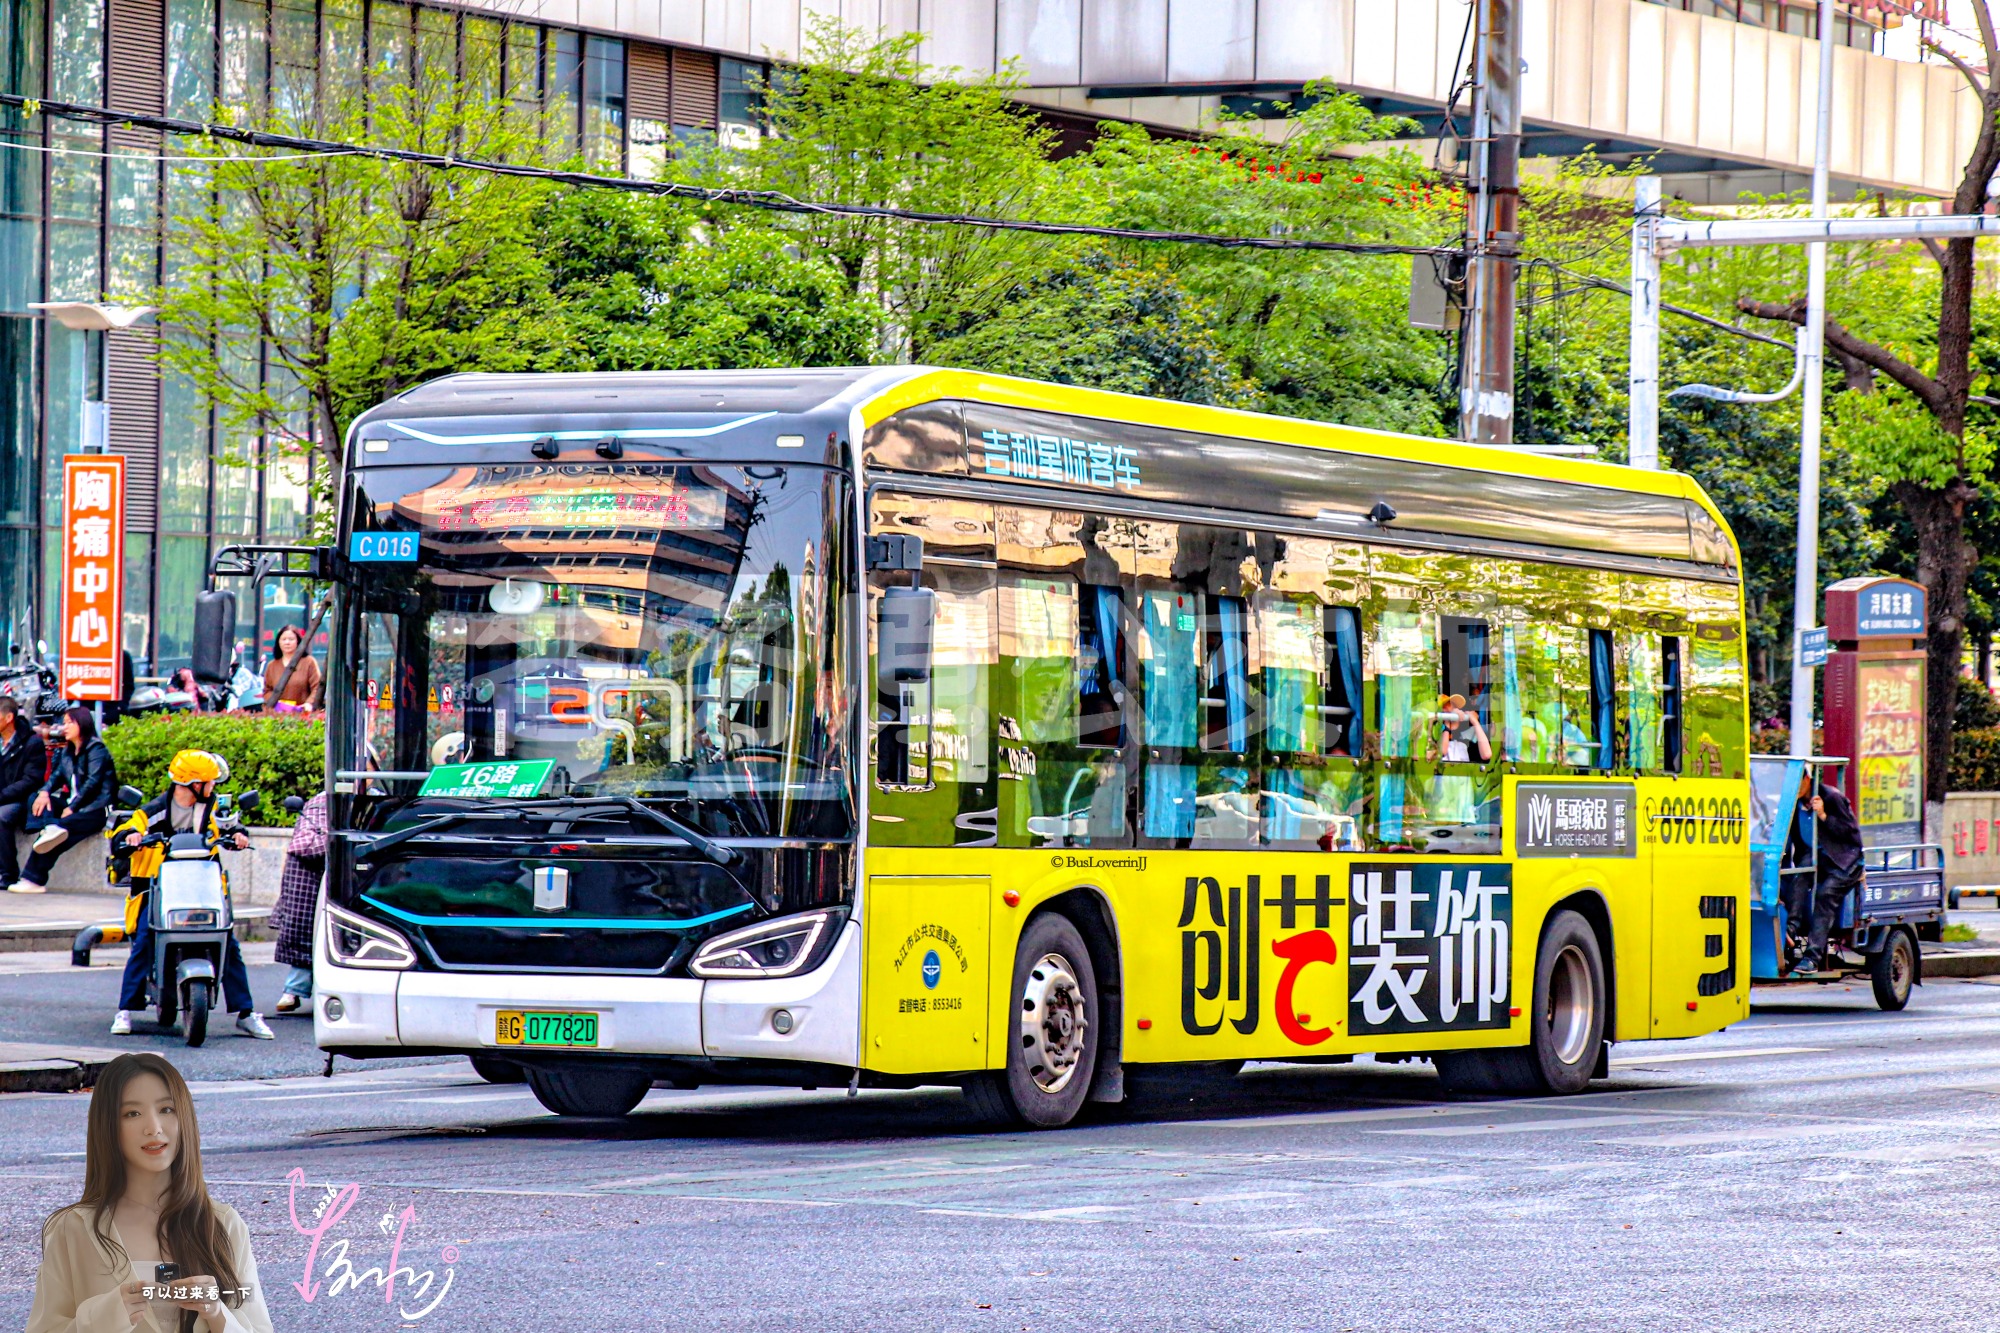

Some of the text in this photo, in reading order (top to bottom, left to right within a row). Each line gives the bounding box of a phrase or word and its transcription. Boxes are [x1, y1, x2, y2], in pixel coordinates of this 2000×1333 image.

[981, 428, 1142, 490] 吉利星际客车
[71, 471, 112, 648] 胸痛中心
[359, 536, 412, 557] C 016
[459, 764, 520, 787] 16路
[1555, 798, 1607, 830] 馬頭家居
[1660, 796, 1742, 844] 8981200
[1555, 833, 1575, 846] HORSE
[1575, 833, 1591, 846] HEAD
[893, 923, 969, 973] 九江市公共交通集团公司
[1177, 870, 1509, 1046] 创艺装饰
